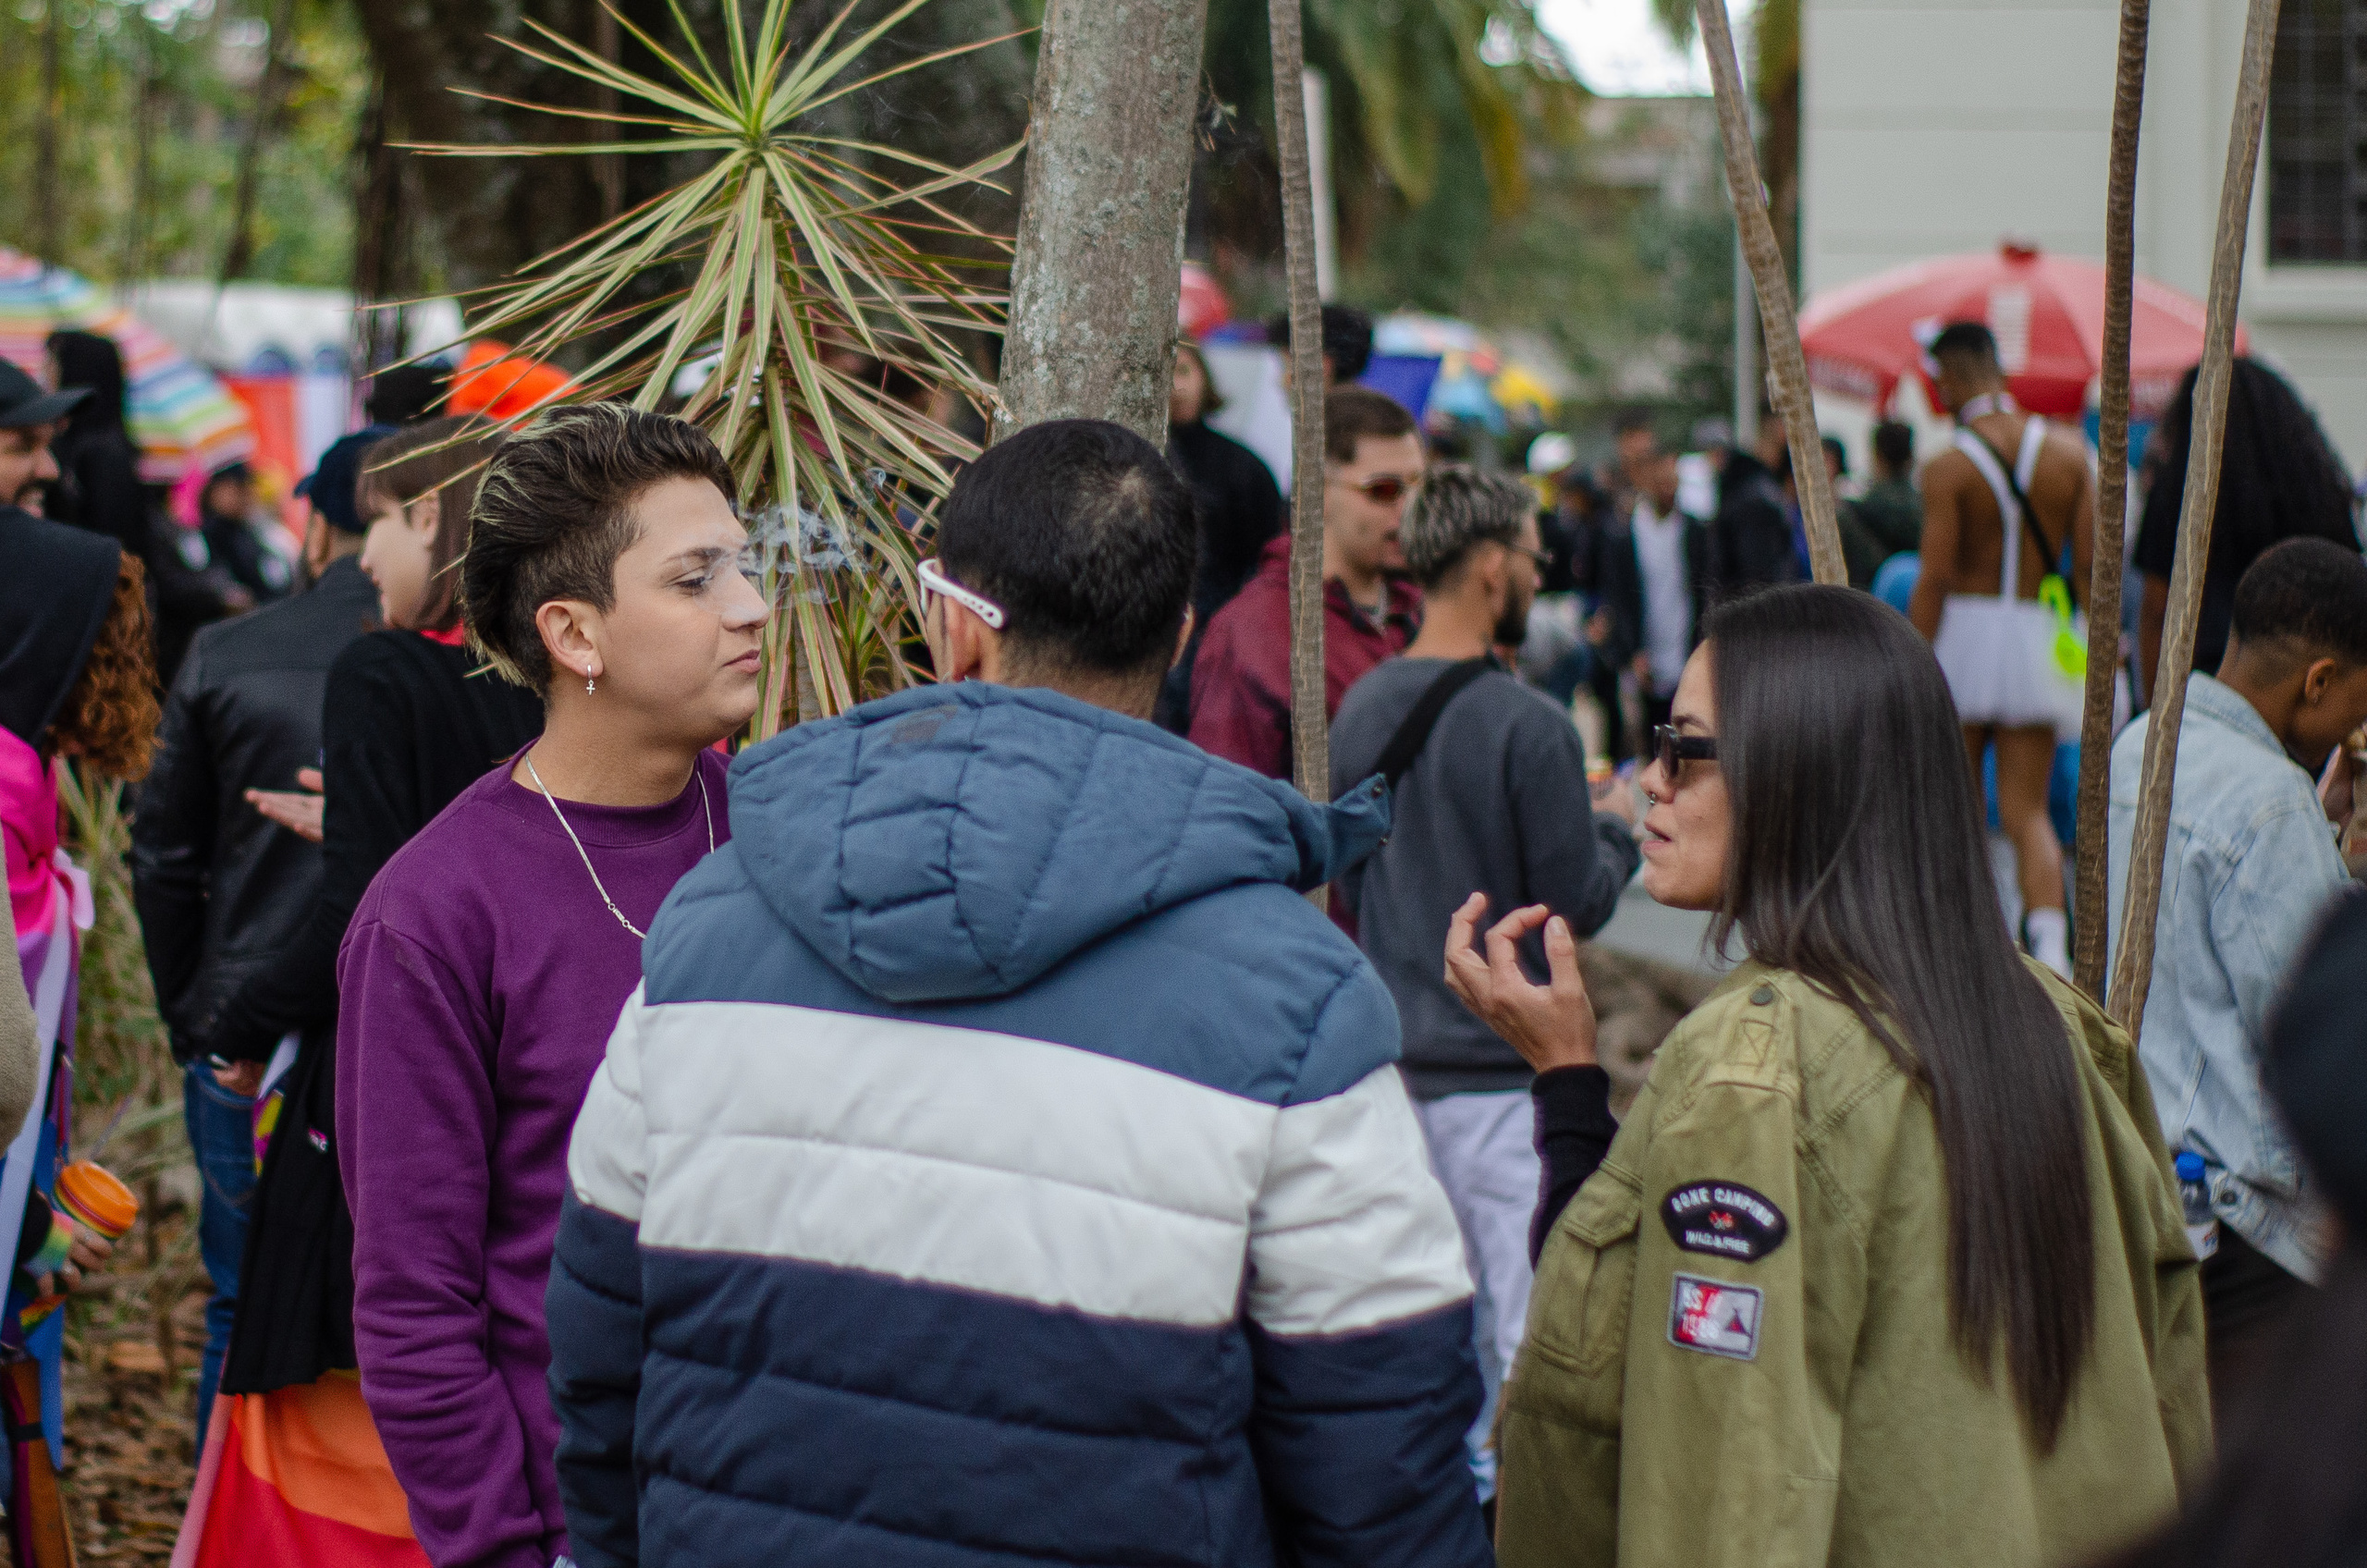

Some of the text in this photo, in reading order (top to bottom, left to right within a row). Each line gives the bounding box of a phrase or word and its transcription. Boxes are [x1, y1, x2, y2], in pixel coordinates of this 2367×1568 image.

[1671, 1187, 1775, 1227] GONE CAMPING
[1686, 1230, 1712, 1245] WILD
[1723, 1237, 1749, 1254] FREE
